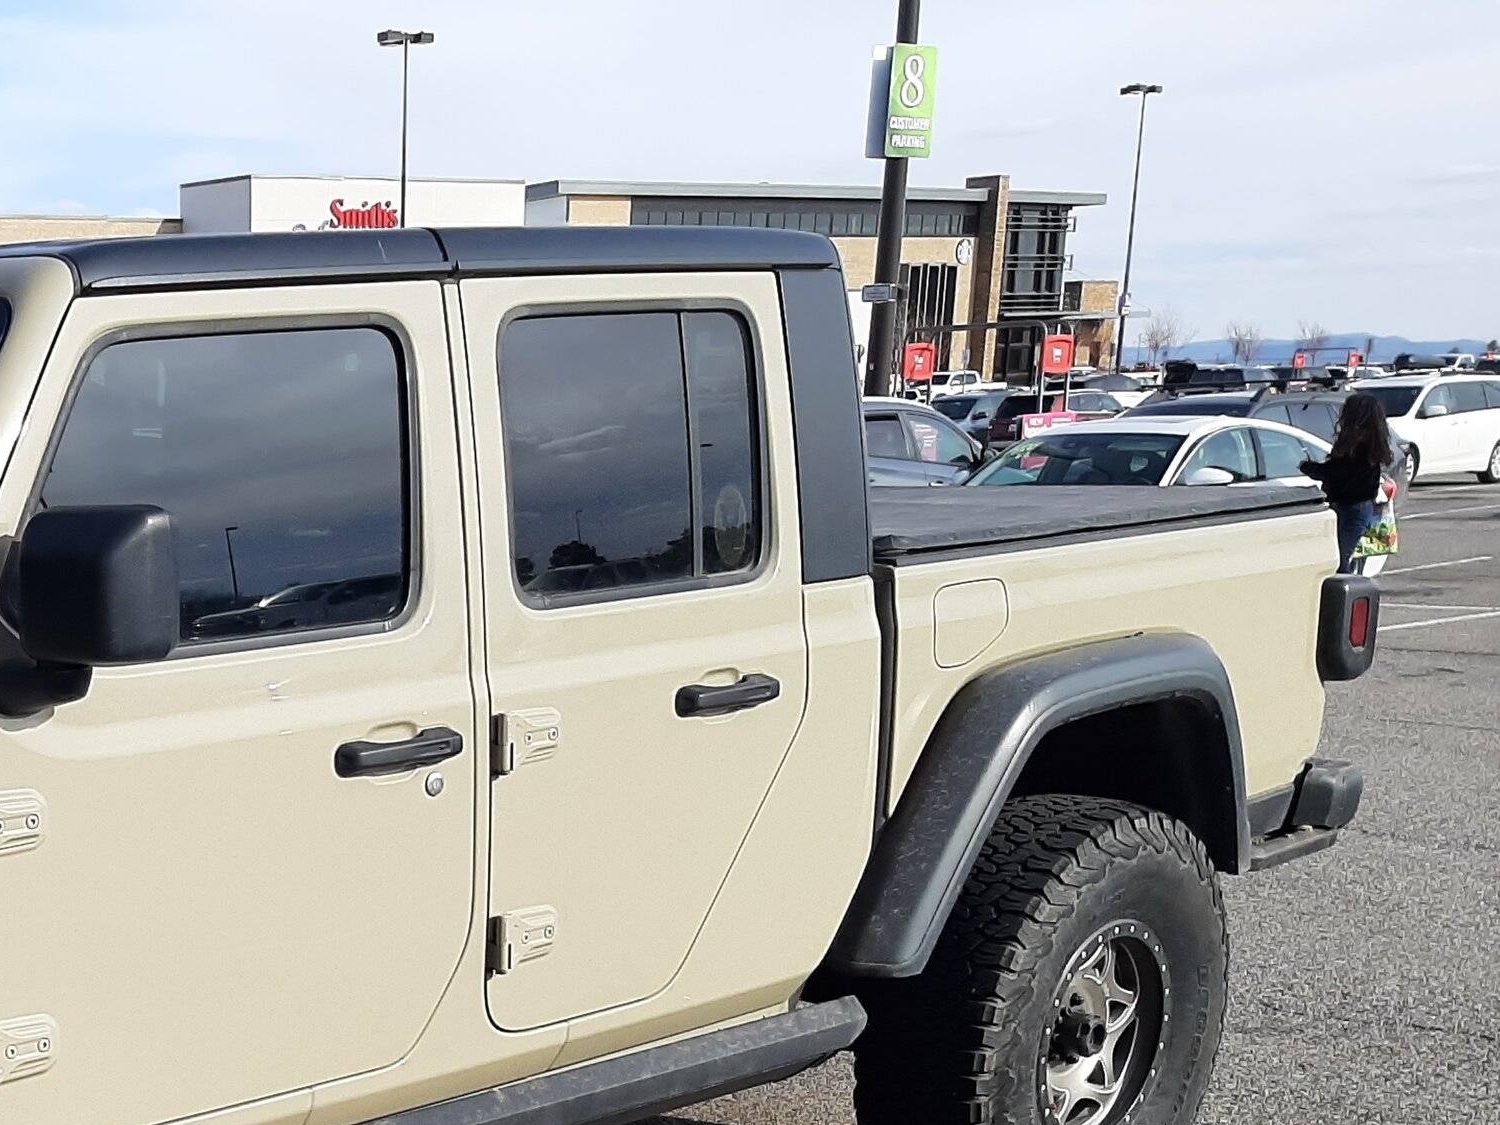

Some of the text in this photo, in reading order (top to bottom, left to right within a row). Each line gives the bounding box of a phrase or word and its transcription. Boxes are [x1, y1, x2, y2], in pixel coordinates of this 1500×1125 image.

[900, 54, 925, 108] 8
[889, 115, 931, 131] CUSTOMER
[891, 134, 925, 149] PARKING
[329, 198, 399, 229] Smith's
